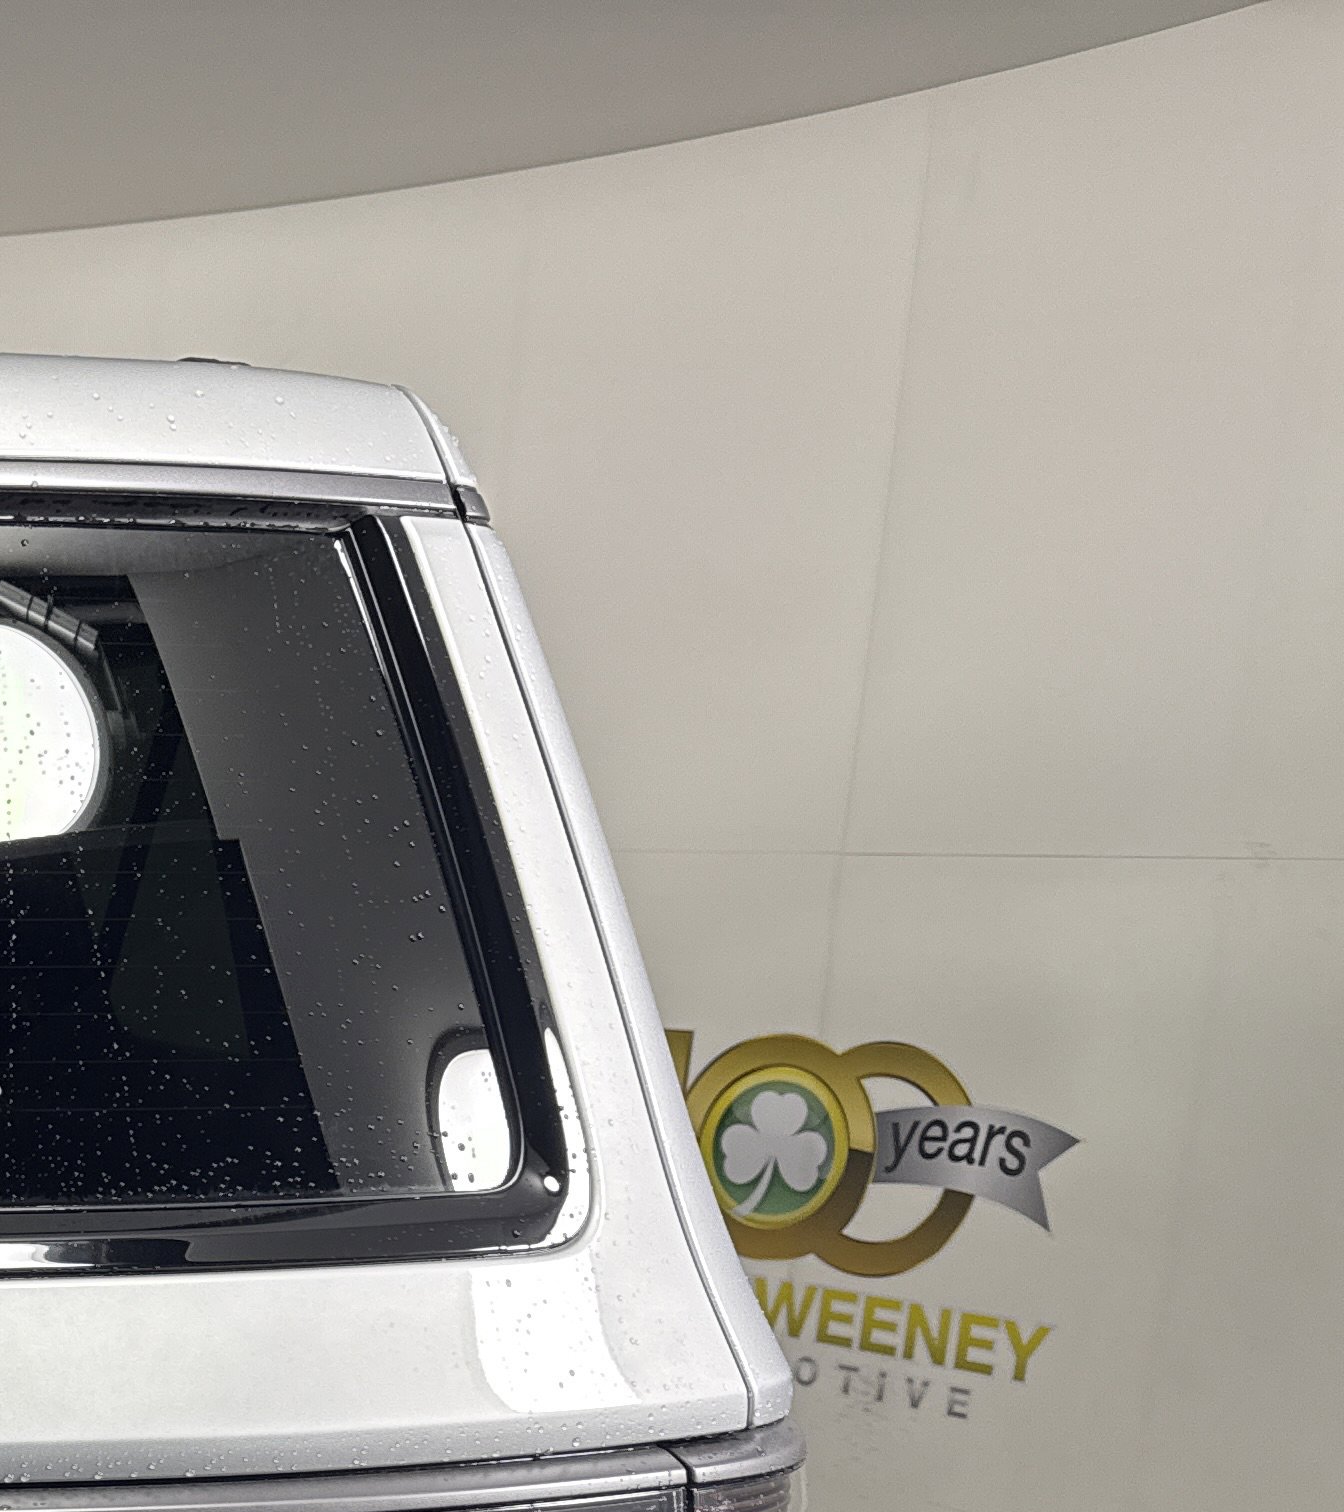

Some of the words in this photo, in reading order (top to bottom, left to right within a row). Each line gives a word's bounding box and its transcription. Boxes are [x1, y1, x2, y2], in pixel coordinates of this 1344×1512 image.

[884, 1118, 1032, 1177] years
[752, 1277, 1051, 1382] WEENEY
[794, 1356, 971, 1420] OTIVE
